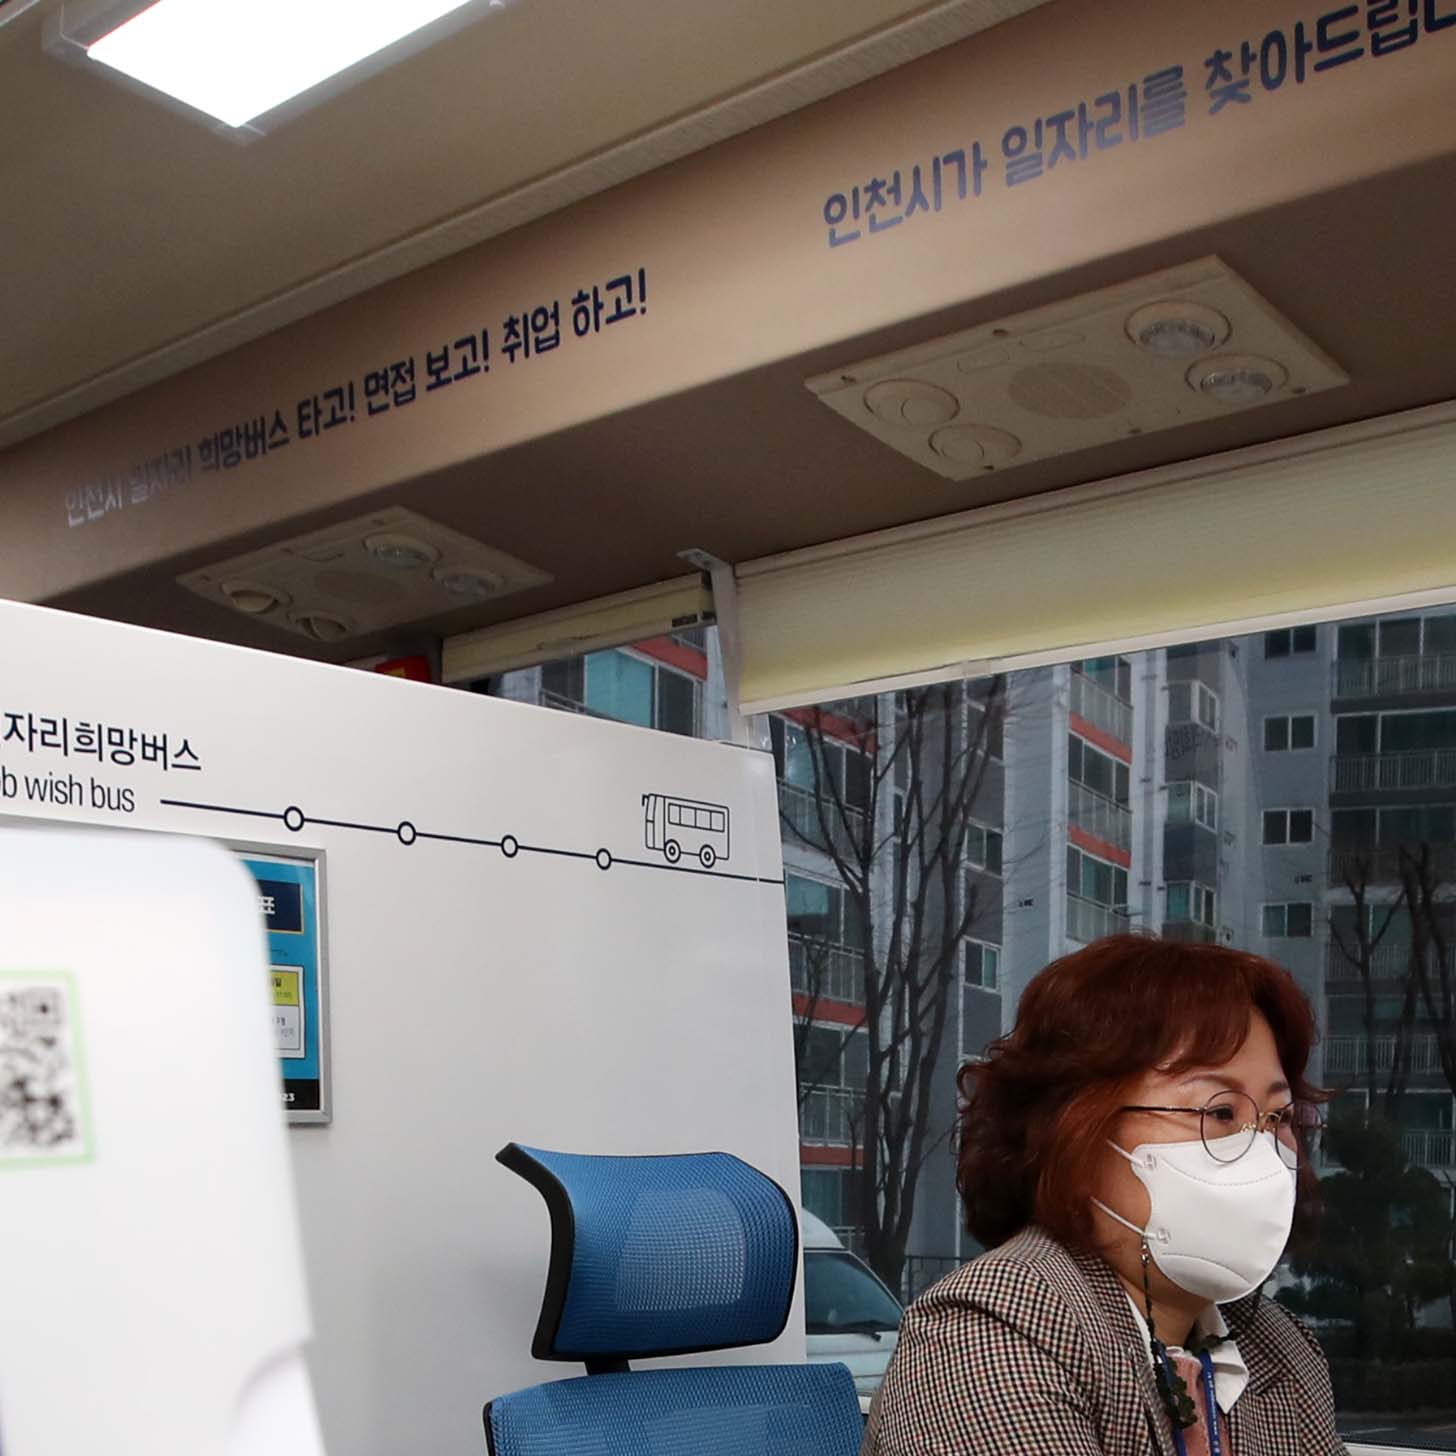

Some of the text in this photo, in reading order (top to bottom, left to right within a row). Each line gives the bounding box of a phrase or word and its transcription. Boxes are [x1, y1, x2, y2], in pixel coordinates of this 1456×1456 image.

[823, 141, 987, 248] 인천시가
[1001, 64, 1187, 188] 일자리를
[64, 471, 123, 527] 인천시
[197, 408, 290, 471] 희망버스
[297, 380, 356, 439] 타고!
[363, 356, 416, 416] 면접
[425, 327, 490, 392] 보고!
[501, 300, 560, 364] 취업
[570, 267, 647, 337] 하고!
[24, 771, 83, 806] wish
[90, 777, 136, 813] bus
